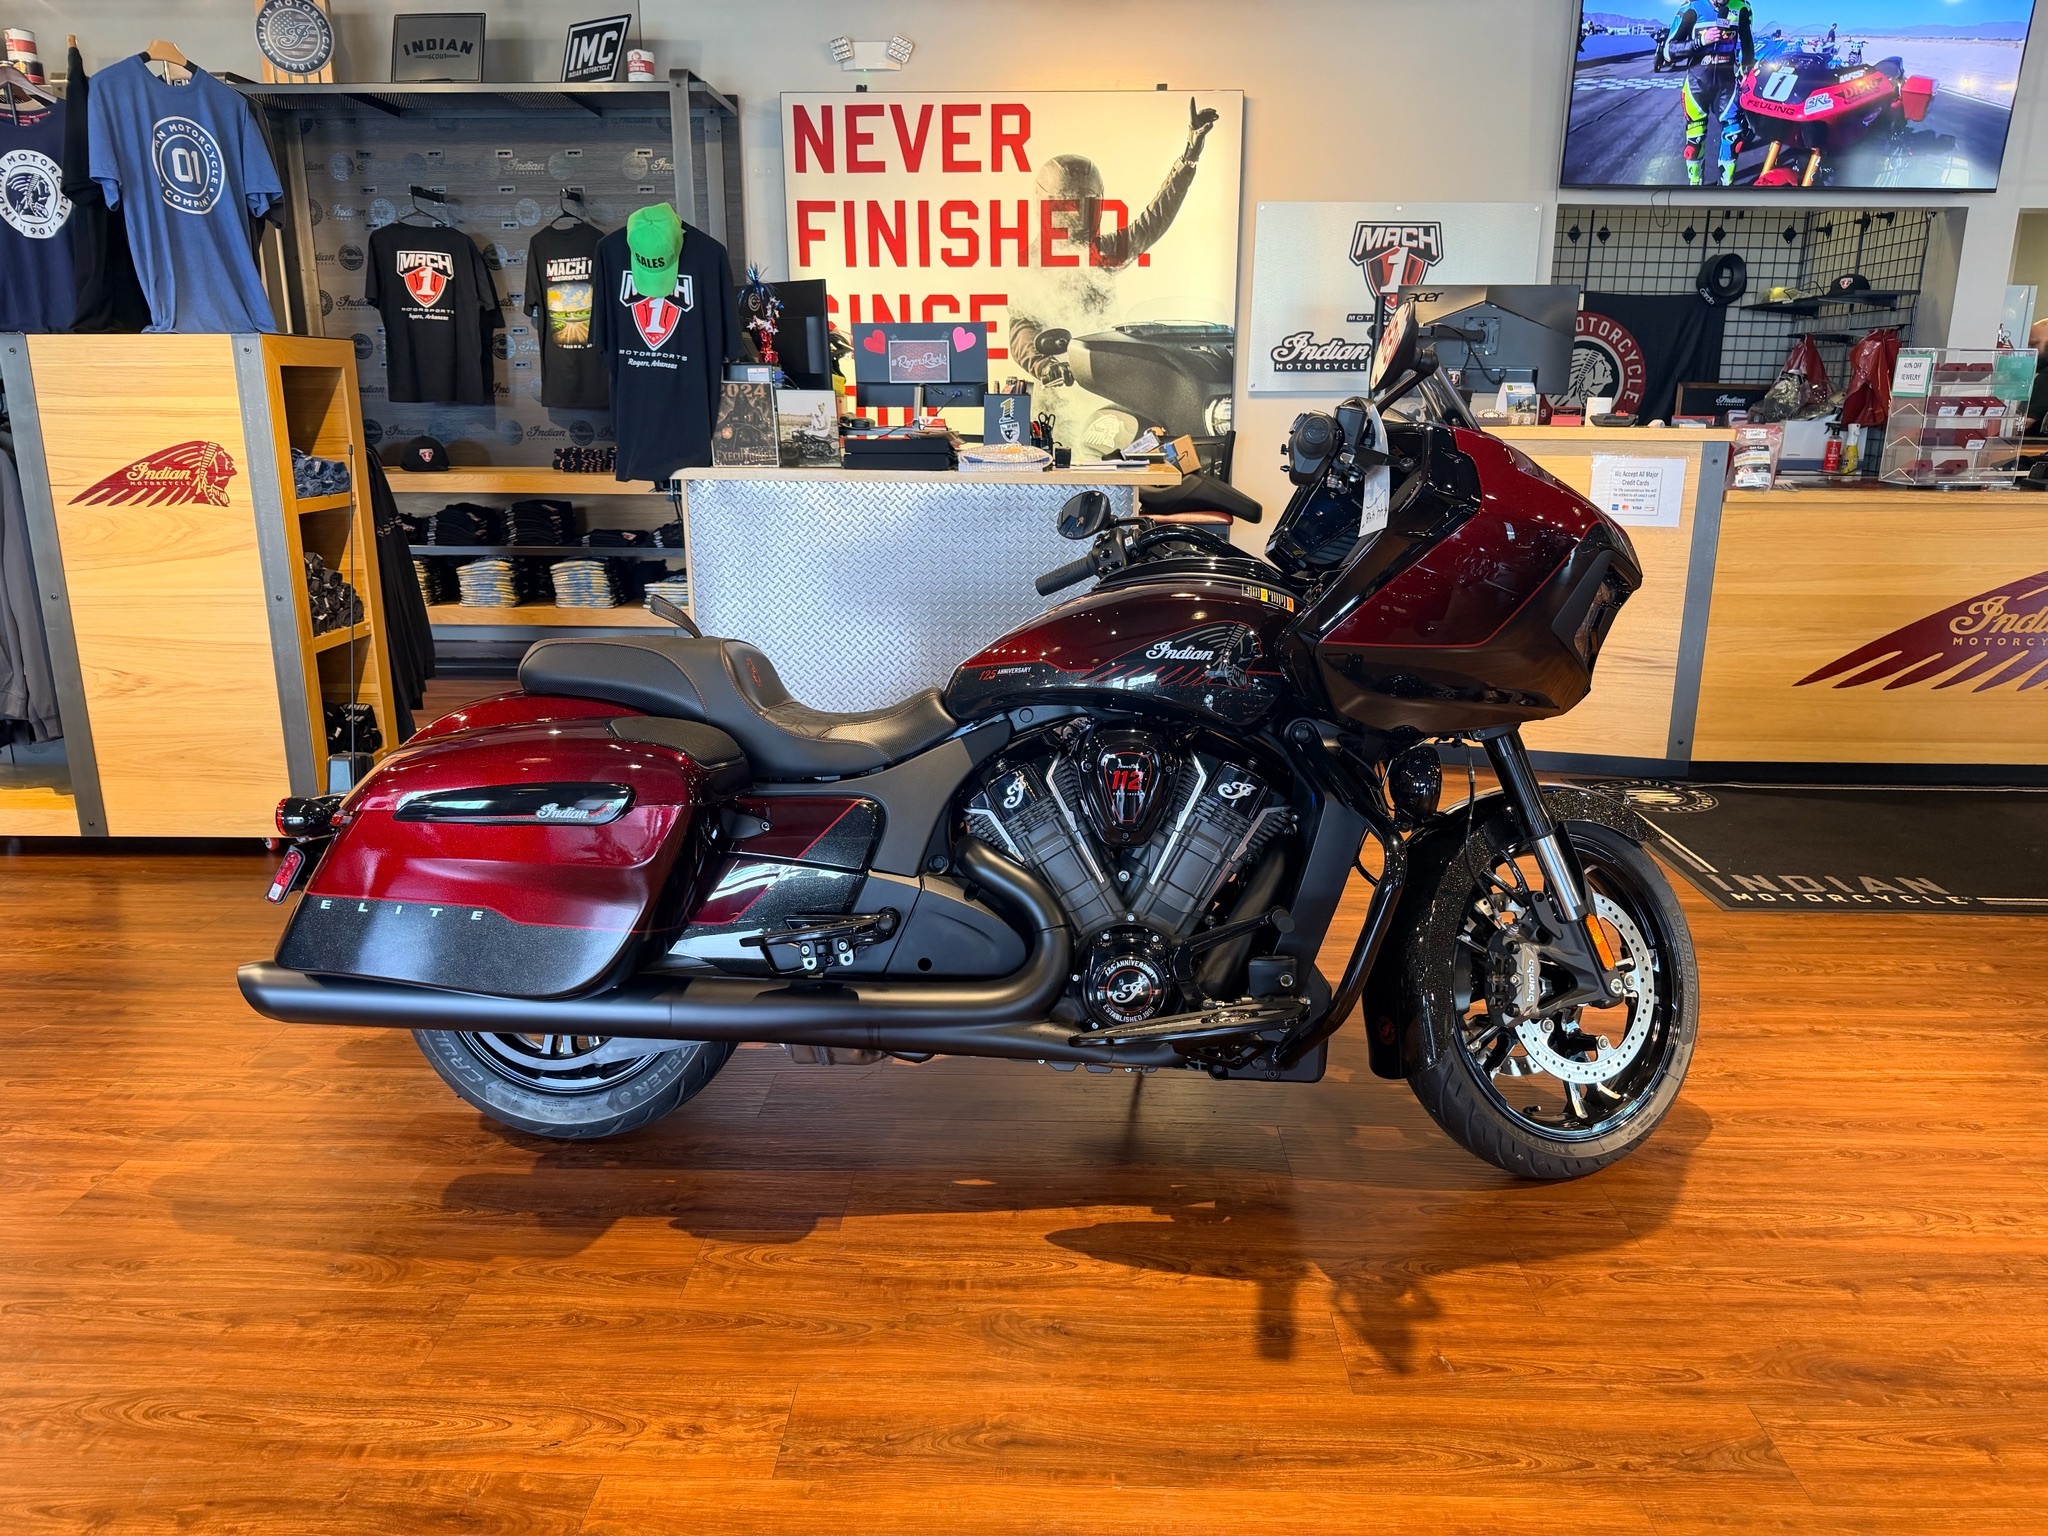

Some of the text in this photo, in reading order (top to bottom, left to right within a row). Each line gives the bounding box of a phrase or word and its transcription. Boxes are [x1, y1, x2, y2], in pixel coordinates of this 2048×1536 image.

[258, 0, 330, 59] INDIAN MOTORCYCLE
[403, 38, 474, 56] INDIAN
[569, 30, 618, 71] IMC
[567, 63, 612, 79] INDIAN MOTORCYCLE
[1771, 75, 1787, 97] 1
[1747, 99, 1796, 115] FEULING
[792, 103, 1032, 173] NEVER
[168, 124, 219, 185] MOTORCYCLE
[504, 157, 546, 171] Indian
[171, 147, 201, 185] 01
[165, 189, 211, 208] COMPANY
[796, 200, 1151, 268] FINISHED.
[1355, 227, 1438, 257] MACH
[400, 253, 452, 275] MACH
[546, 259, 593, 277] MACH 1
[634, 252, 666, 269] SALES
[1380, 246, 1409, 293] 1
[416, 266, 436, 296] 1
[1407, 292, 1444, 303] acer
[1699, 287, 1715, 305] Cardo
[401, 307, 455, 315] MOTORSPORTS
[645, 296, 666, 334] 1
[618, 349, 688, 361] MOTORSPORTS
[1272, 333, 1370, 361] Indian
[650, 360, 678, 369] Arkansas
[1575, 316, 1642, 404] OTORCYCLE
[1716, 394, 1746, 404] Indian
[526, 424, 566, 437] Indian
[126, 462, 191, 481] Indian
[1645, 471, 1659, 479] Major
[1145, 641, 1214, 661] Indian
[979, 666, 1032, 681] 125 ANNIVERSARY
[1112, 770, 1144, 790] 112
[536, 803, 590, 819] Indian
[1706, 874, 1950, 894] INDIAN
[1731, 892, 1968, 905] MOTORCYCLE
[320, 900, 484, 921] ELITE
[1526, 958, 1535, 1002] brembo
[1102, 1003, 1156, 1023] ESTABLISHED 1901
